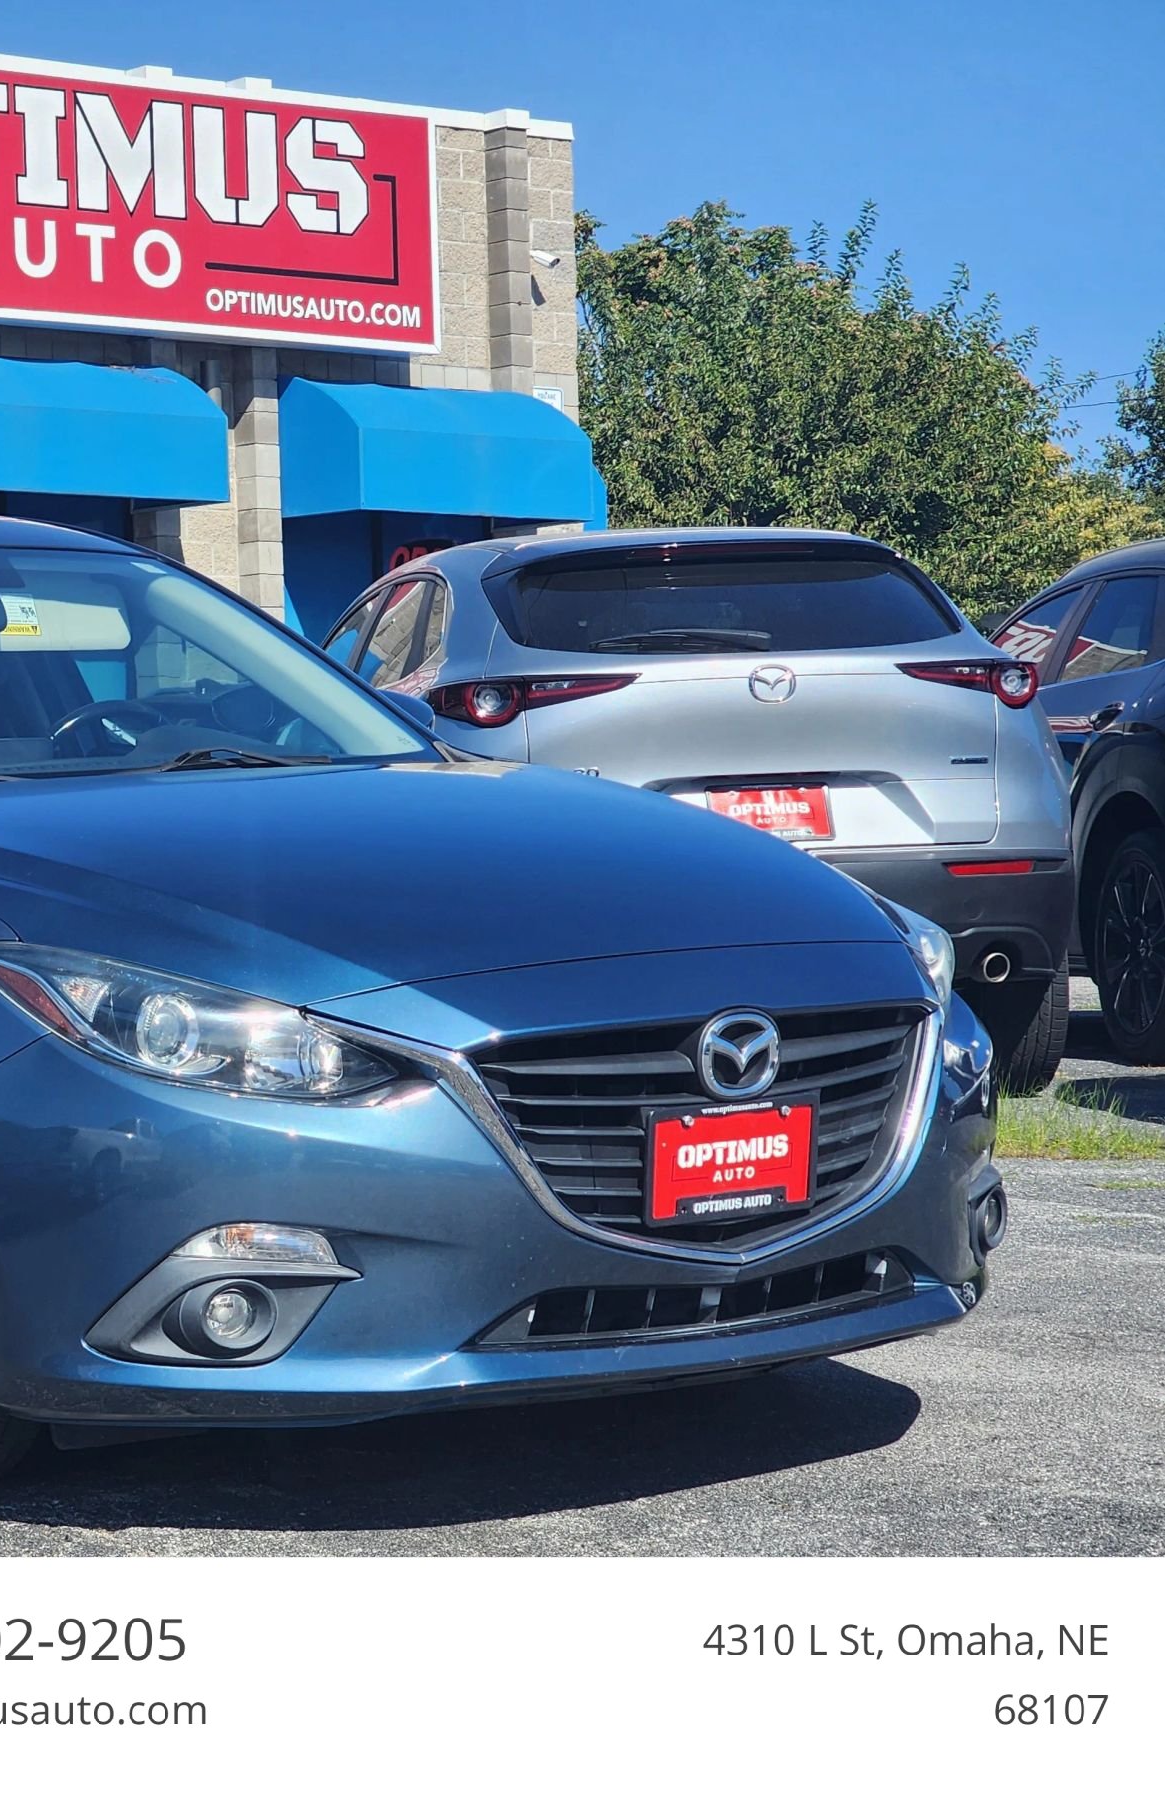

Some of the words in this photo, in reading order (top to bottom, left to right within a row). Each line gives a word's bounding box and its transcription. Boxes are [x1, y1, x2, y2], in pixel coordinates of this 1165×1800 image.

[206, 288, 421, 328] OPTIMUSAUTO.COM
[727, 801, 811, 817] OPTIMUS
[677, 1134, 788, 1169] OPTIMUS
[712, 1166, 756, 1183] AUTO
[693, 1197, 742, 1215] OPTIMUS
[744, 1194, 772, 1208] AUTO
